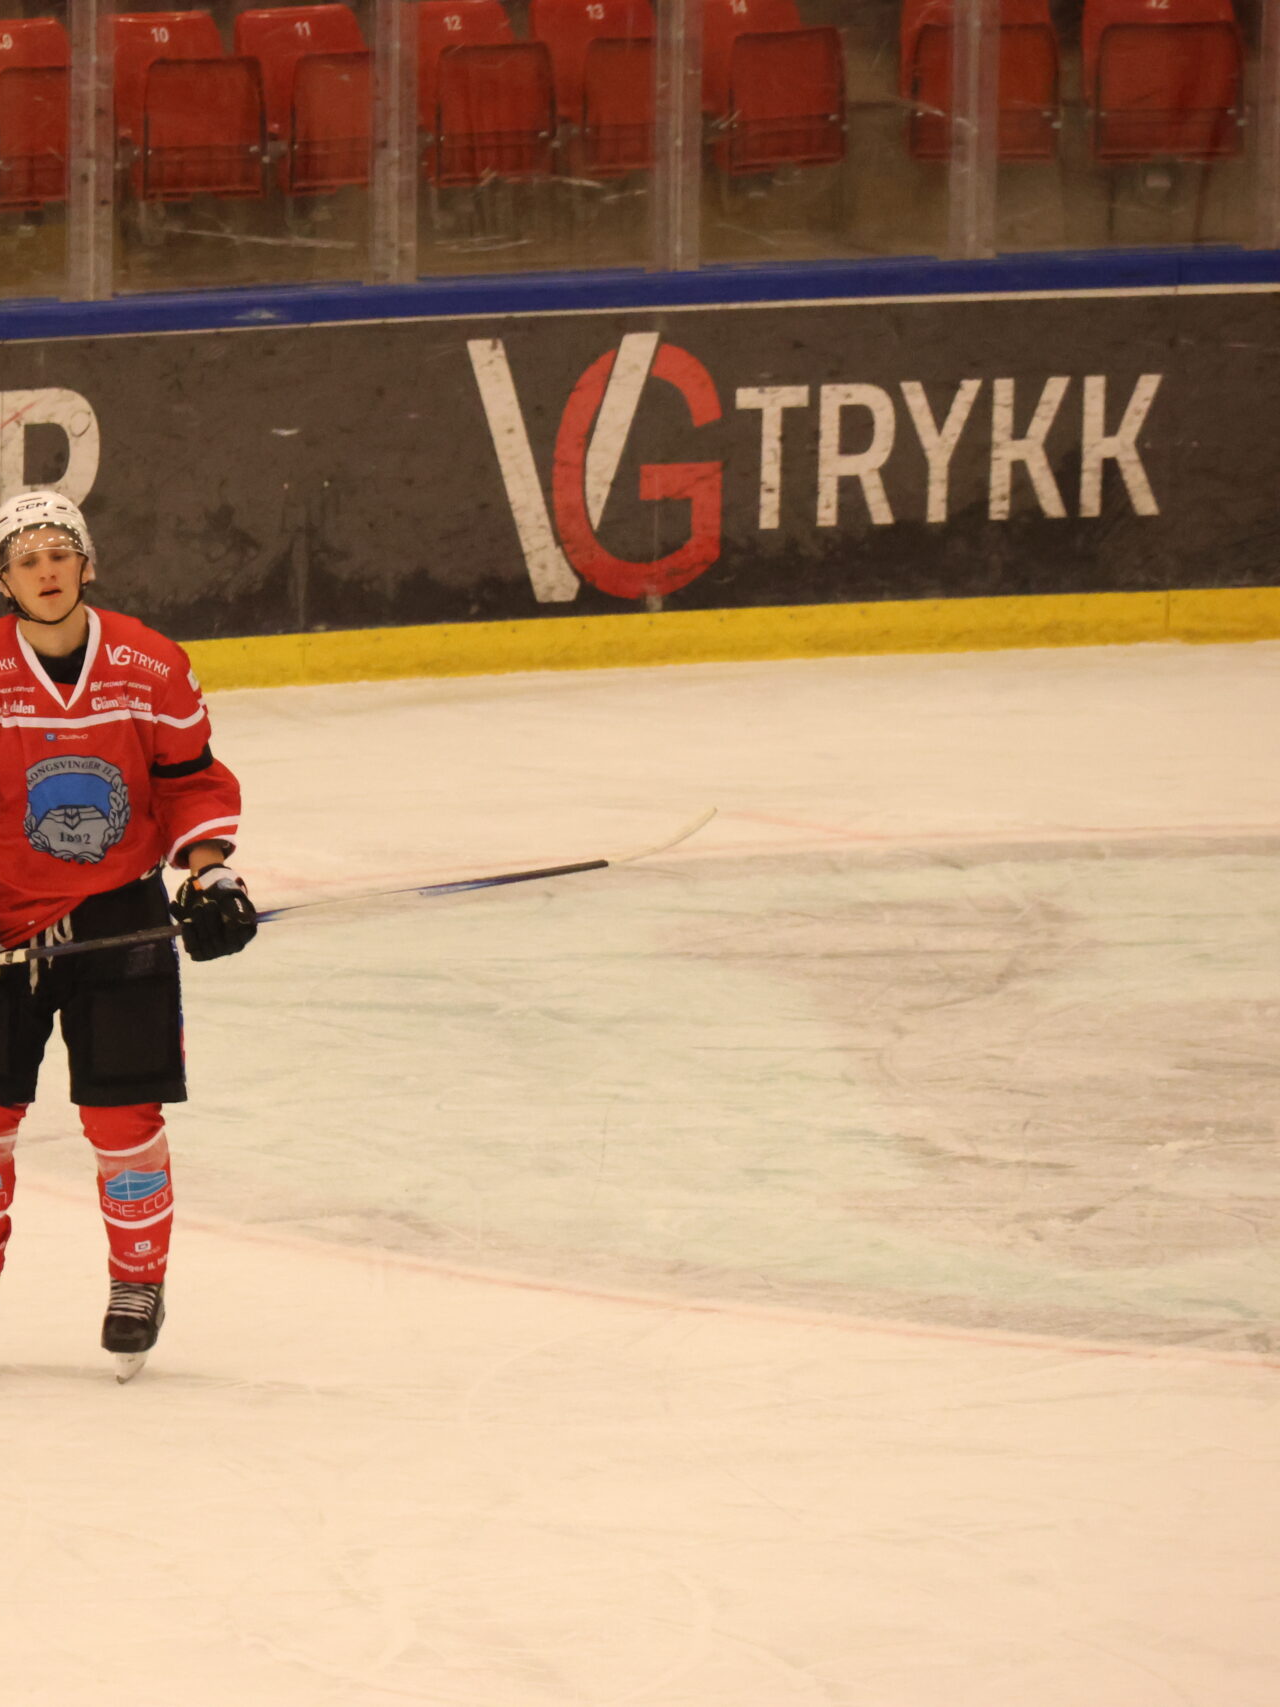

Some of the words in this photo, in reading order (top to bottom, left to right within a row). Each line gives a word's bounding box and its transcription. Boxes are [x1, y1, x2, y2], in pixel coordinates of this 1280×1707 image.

[586, 4, 605, 20] 13
[294, 21, 312, 37] 11
[443, 15, 462, 31] 12
[151, 27, 169, 43] 10
[466, 331, 723, 603] VG
[735, 374, 1163, 530] TRYKK
[15, 501, 48, 513] CCM
[105, 643, 132, 666] VG
[131, 649, 171, 678] TRYKK
